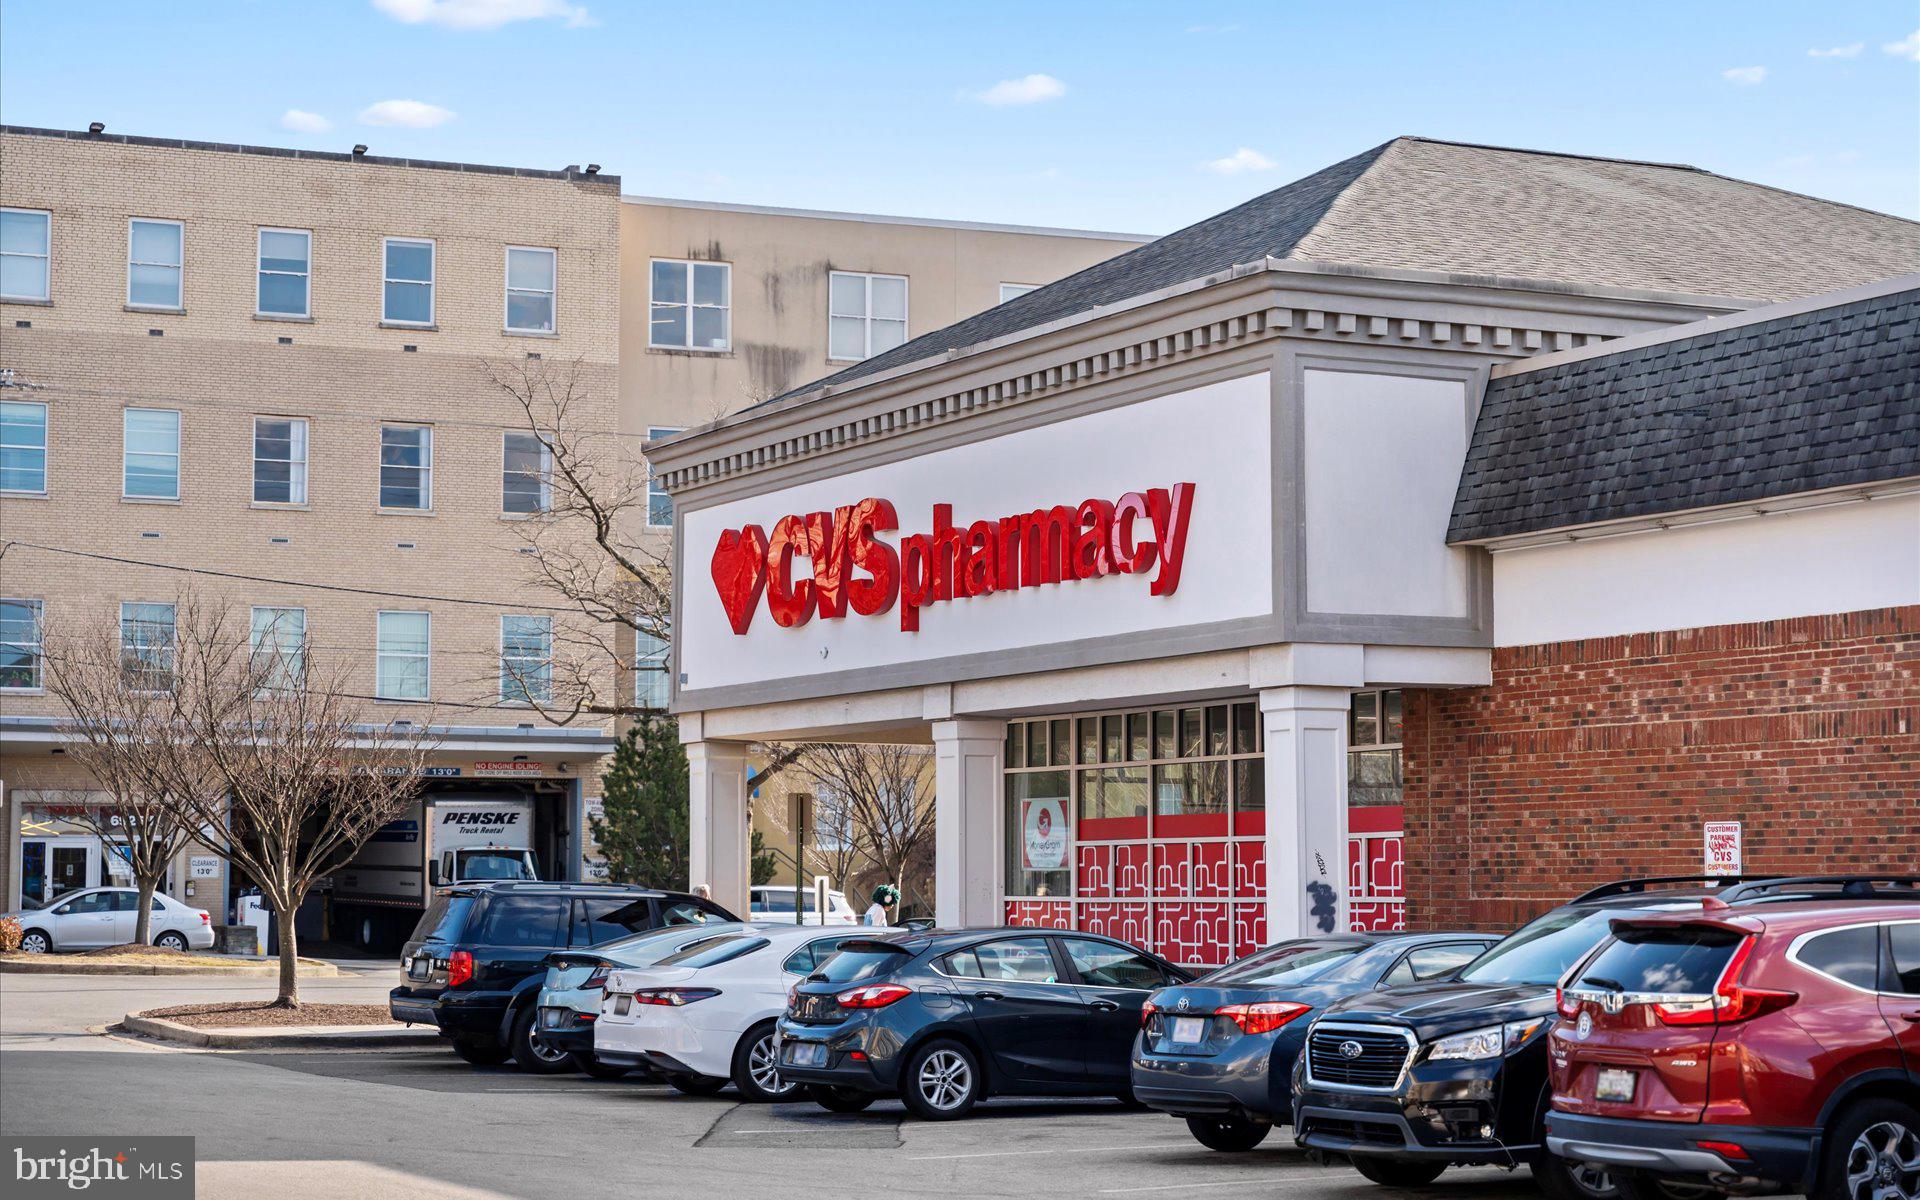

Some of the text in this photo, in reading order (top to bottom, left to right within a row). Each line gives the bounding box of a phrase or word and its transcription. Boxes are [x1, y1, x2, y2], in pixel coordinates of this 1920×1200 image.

[767, 482, 1196, 631] CVS pharmacy
[443, 813, 520, 824] PENSKE
[1714, 851, 1732, 861] CVS
